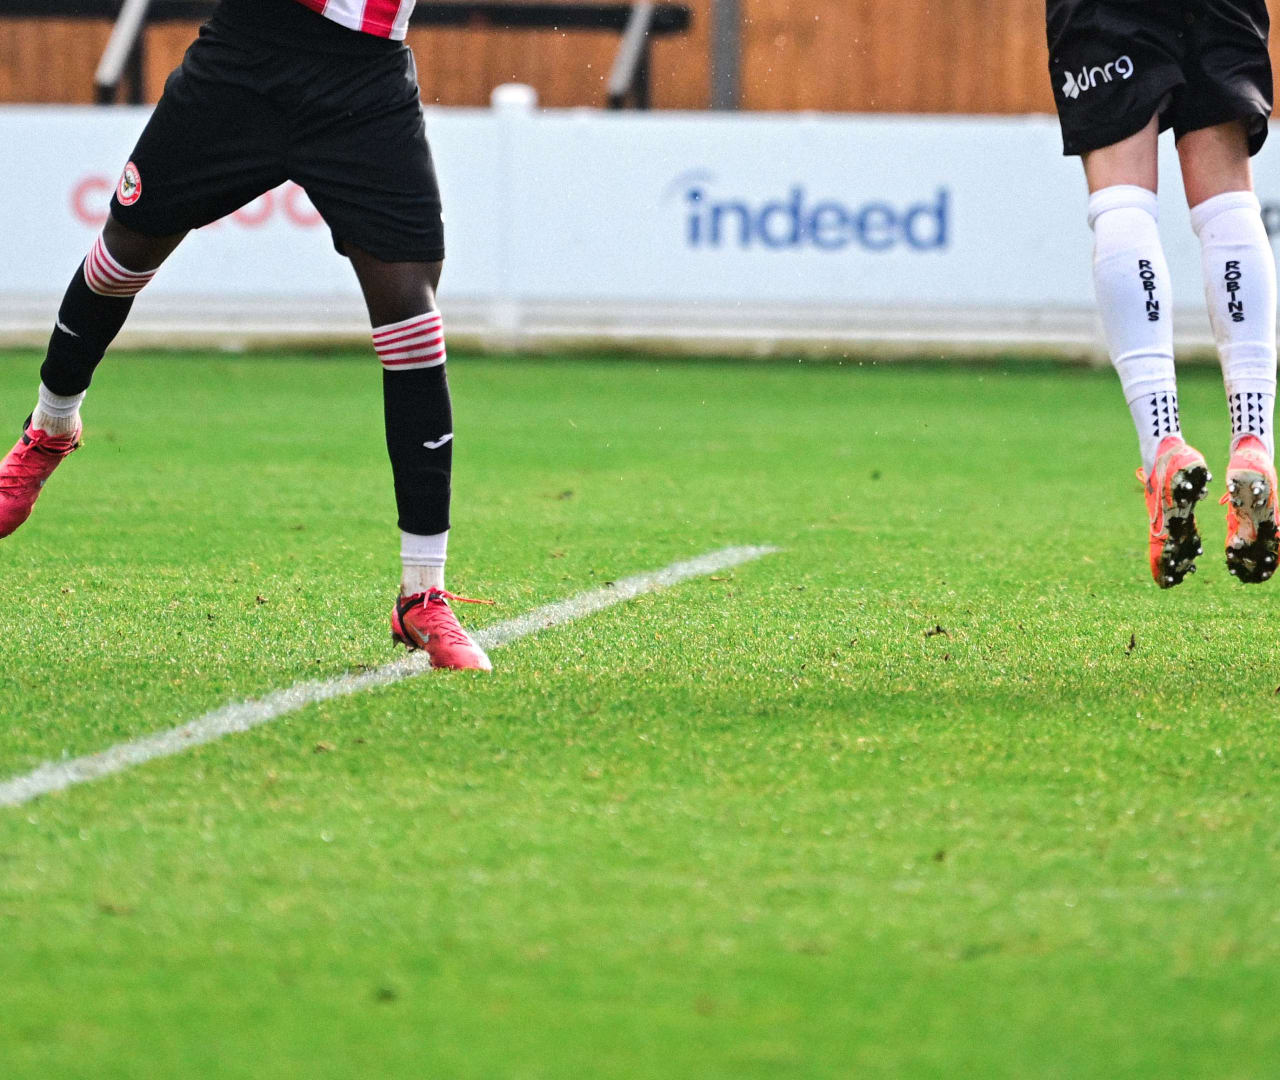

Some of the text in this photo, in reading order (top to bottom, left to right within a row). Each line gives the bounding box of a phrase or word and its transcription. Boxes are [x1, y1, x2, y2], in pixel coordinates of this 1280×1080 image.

[686, 184, 949, 251] indeed
[1138, 260, 1160, 322] ROBINS
[1224, 261, 1245, 323] ROBINS
